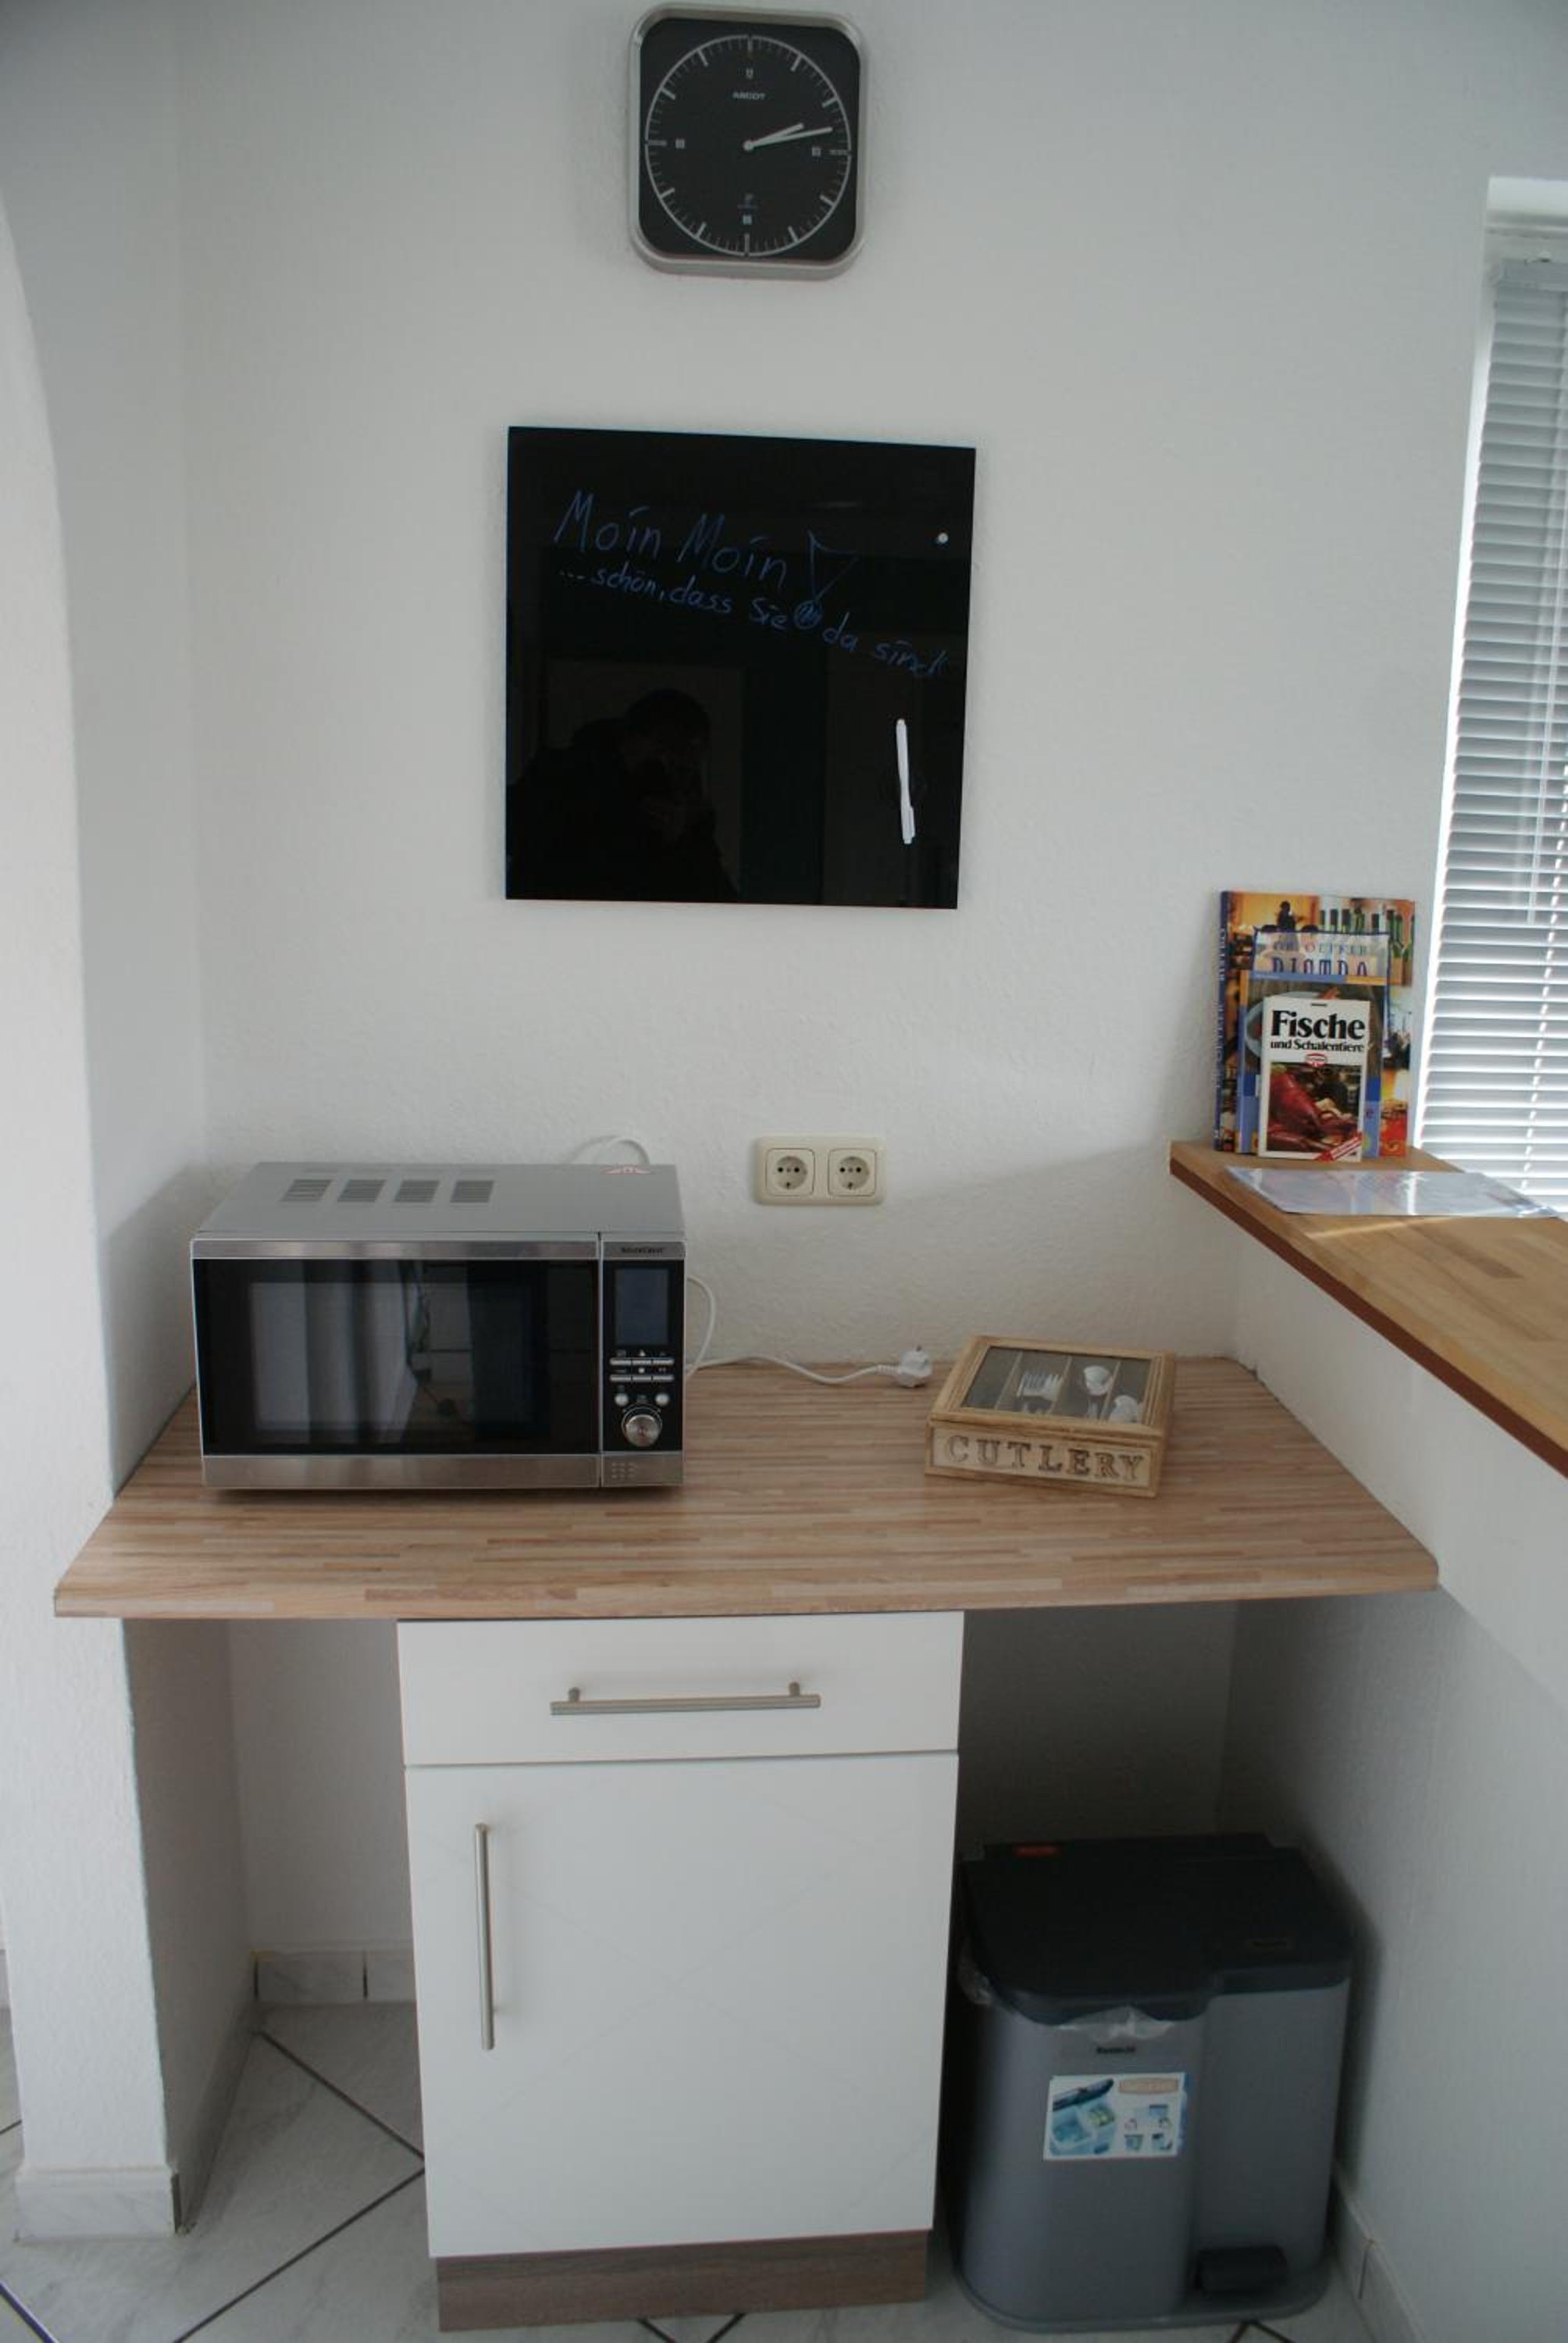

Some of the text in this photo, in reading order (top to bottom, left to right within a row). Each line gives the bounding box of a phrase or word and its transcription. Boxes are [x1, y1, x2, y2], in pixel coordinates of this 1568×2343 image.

[554, 488, 662, 558] Moin
[676, 512, 789, 587] Moin
[749, 597, 788, 630] Sie
[823, 612, 860, 650] da
[1270, 1010, 1366, 1040] Fische
[1270, 1039, 1365, 1053] und Schalentiere
[947, 1435, 1145, 1482] CUTLERY
